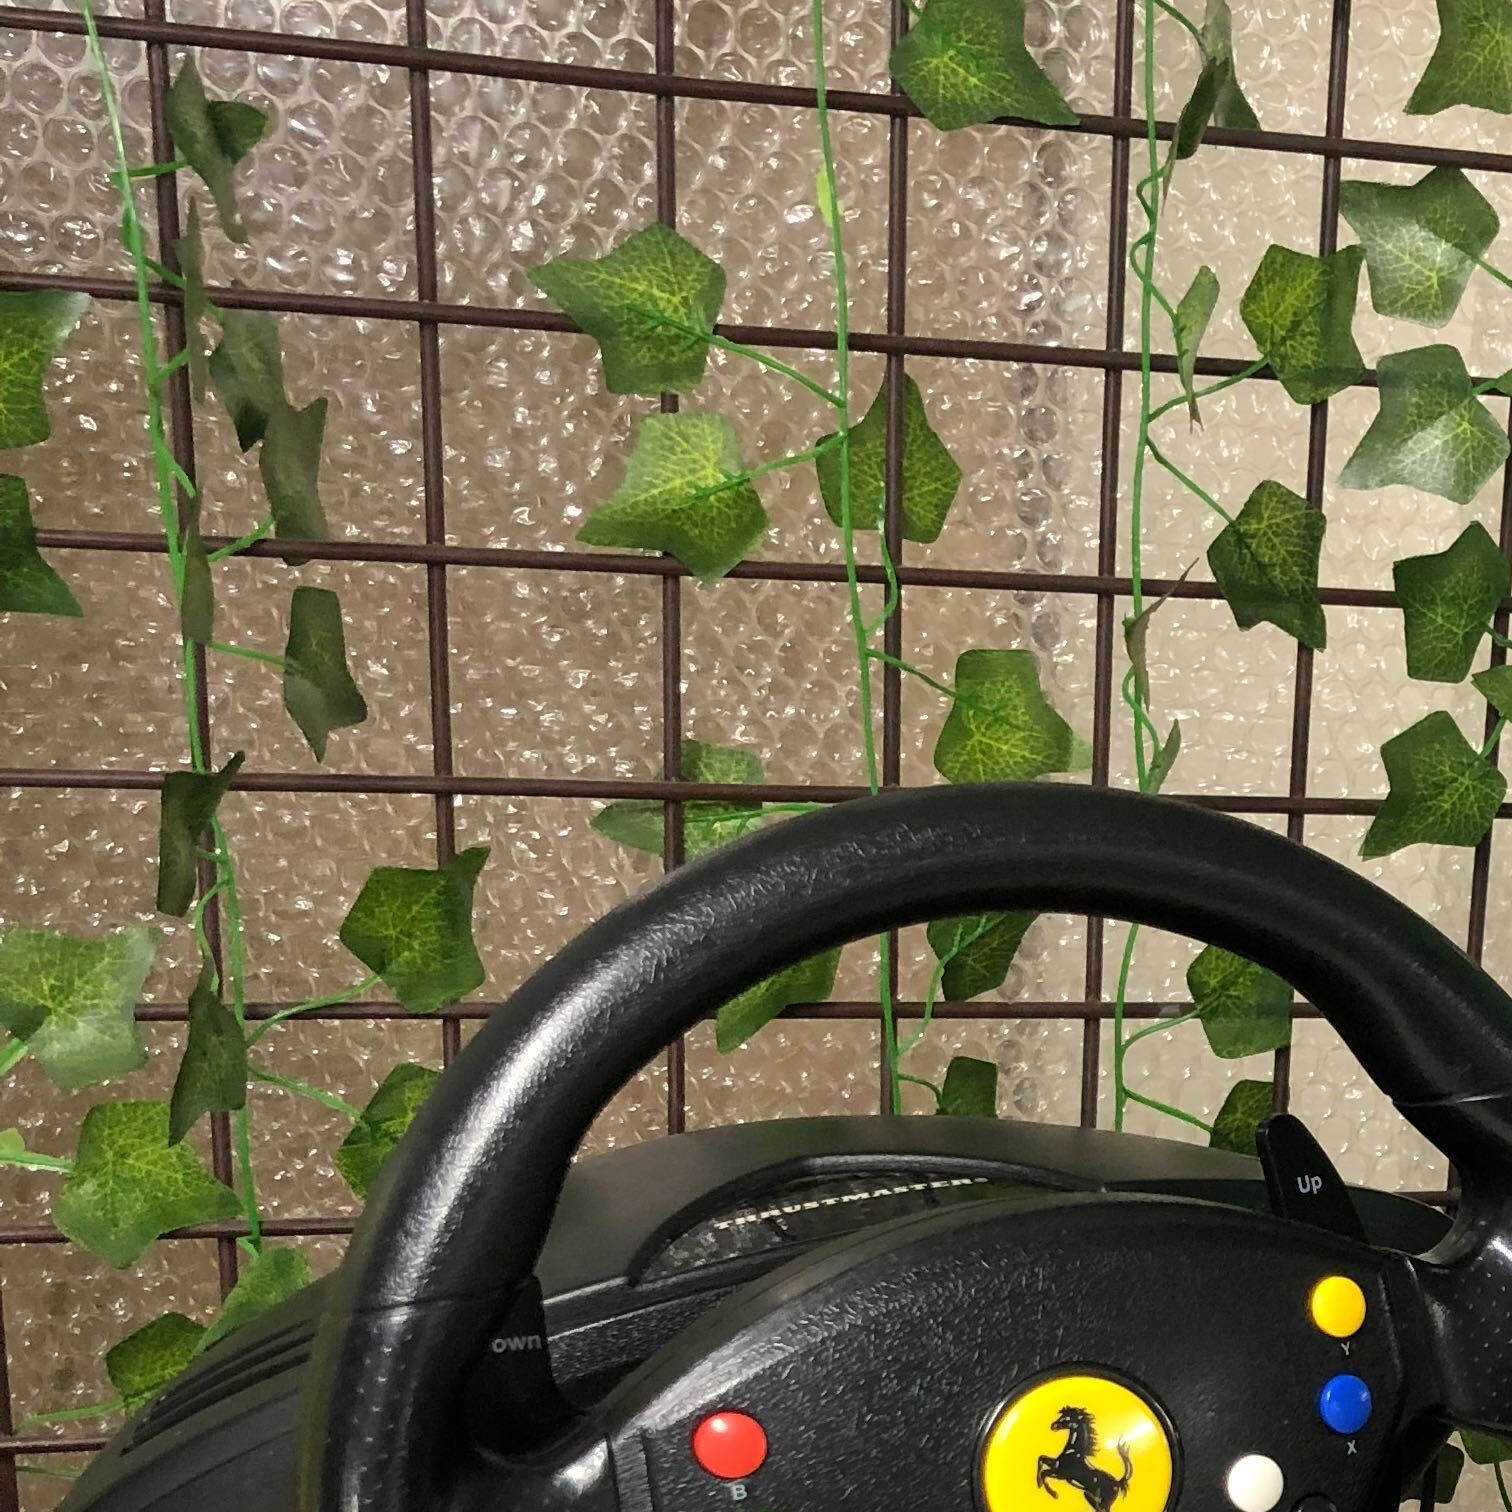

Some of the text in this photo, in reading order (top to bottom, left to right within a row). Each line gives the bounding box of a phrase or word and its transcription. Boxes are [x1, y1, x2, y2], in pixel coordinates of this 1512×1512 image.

[1297, 1174, 1323, 1195] Up
[490, 1334, 543, 1353] own
[1340, 1341, 1351, 1356] Y
[1346, 1439, 1358, 1456] X
[731, 1483, 748, 1501] B
